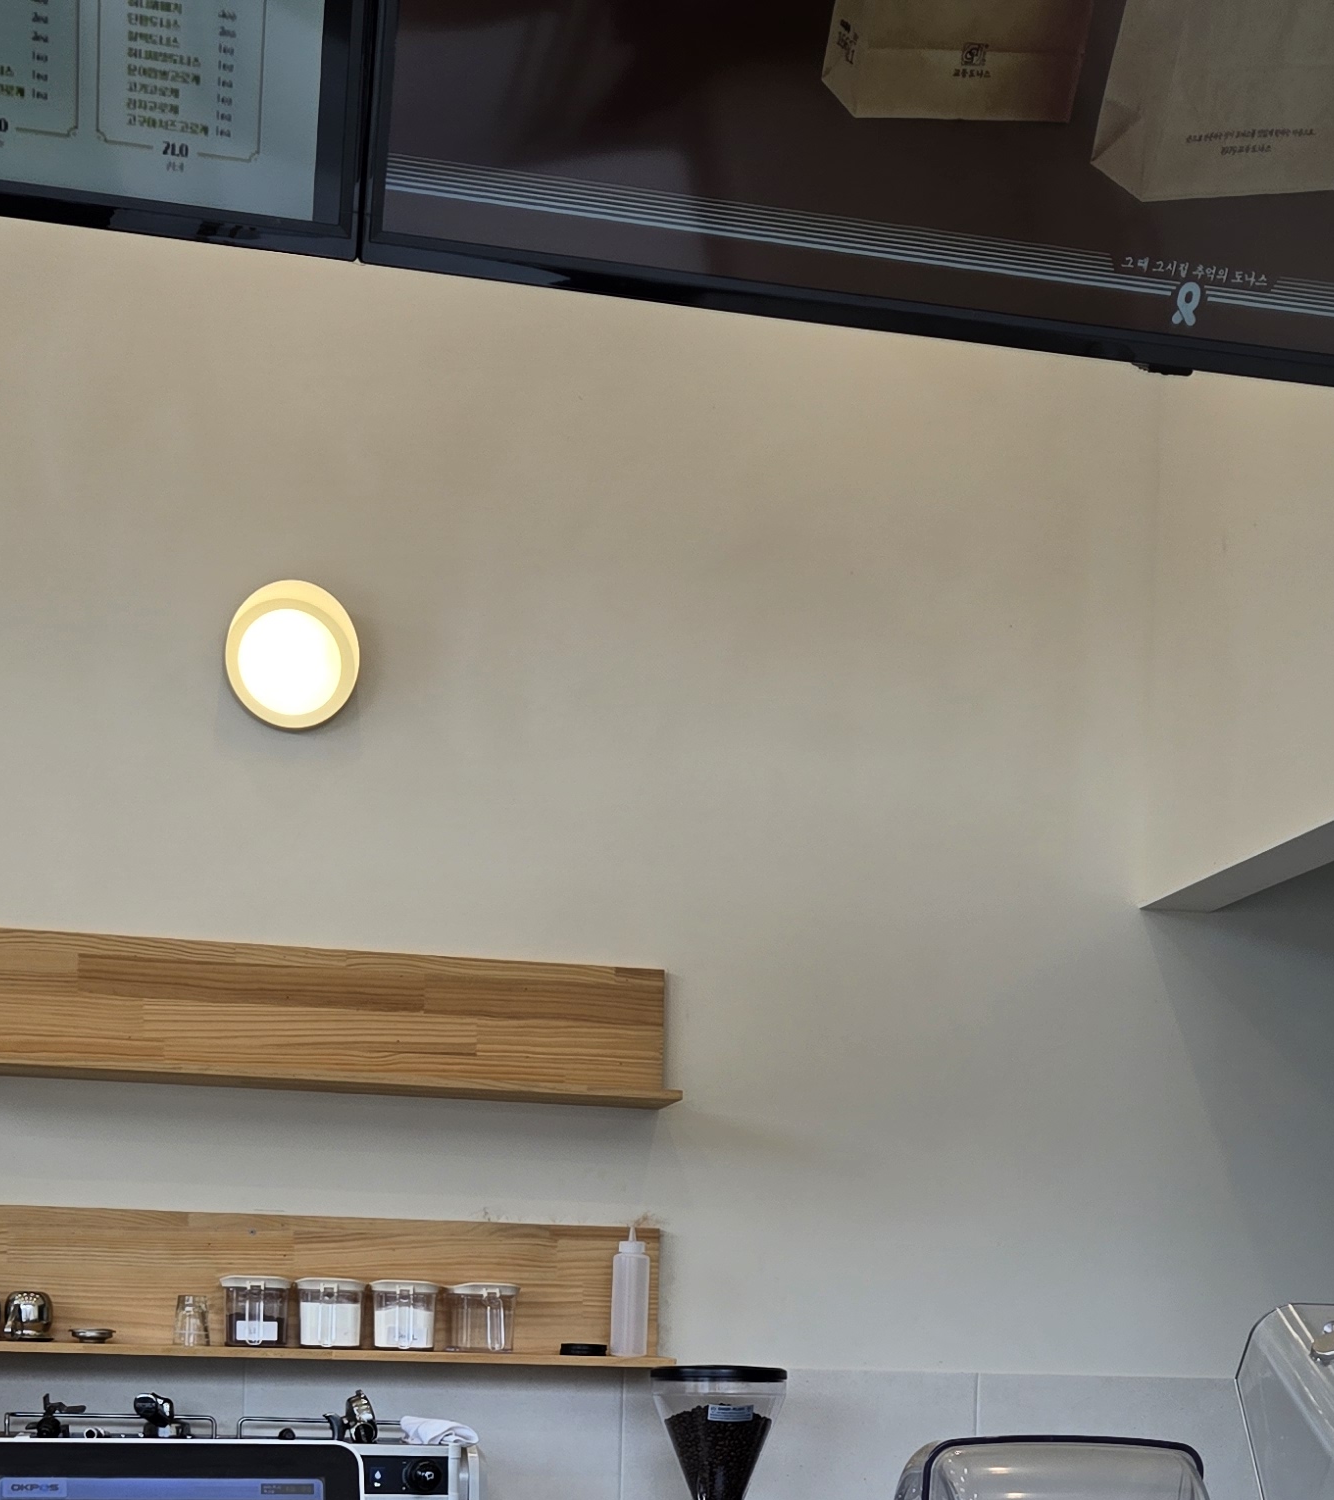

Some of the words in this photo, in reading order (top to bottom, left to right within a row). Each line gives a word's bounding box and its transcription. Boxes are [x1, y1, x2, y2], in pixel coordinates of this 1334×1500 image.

[1192, 264, 1229, 283] 추억의
[1231, 270, 1268, 287] 도나스
[10, 1483, 60, 1493] OKPOS
